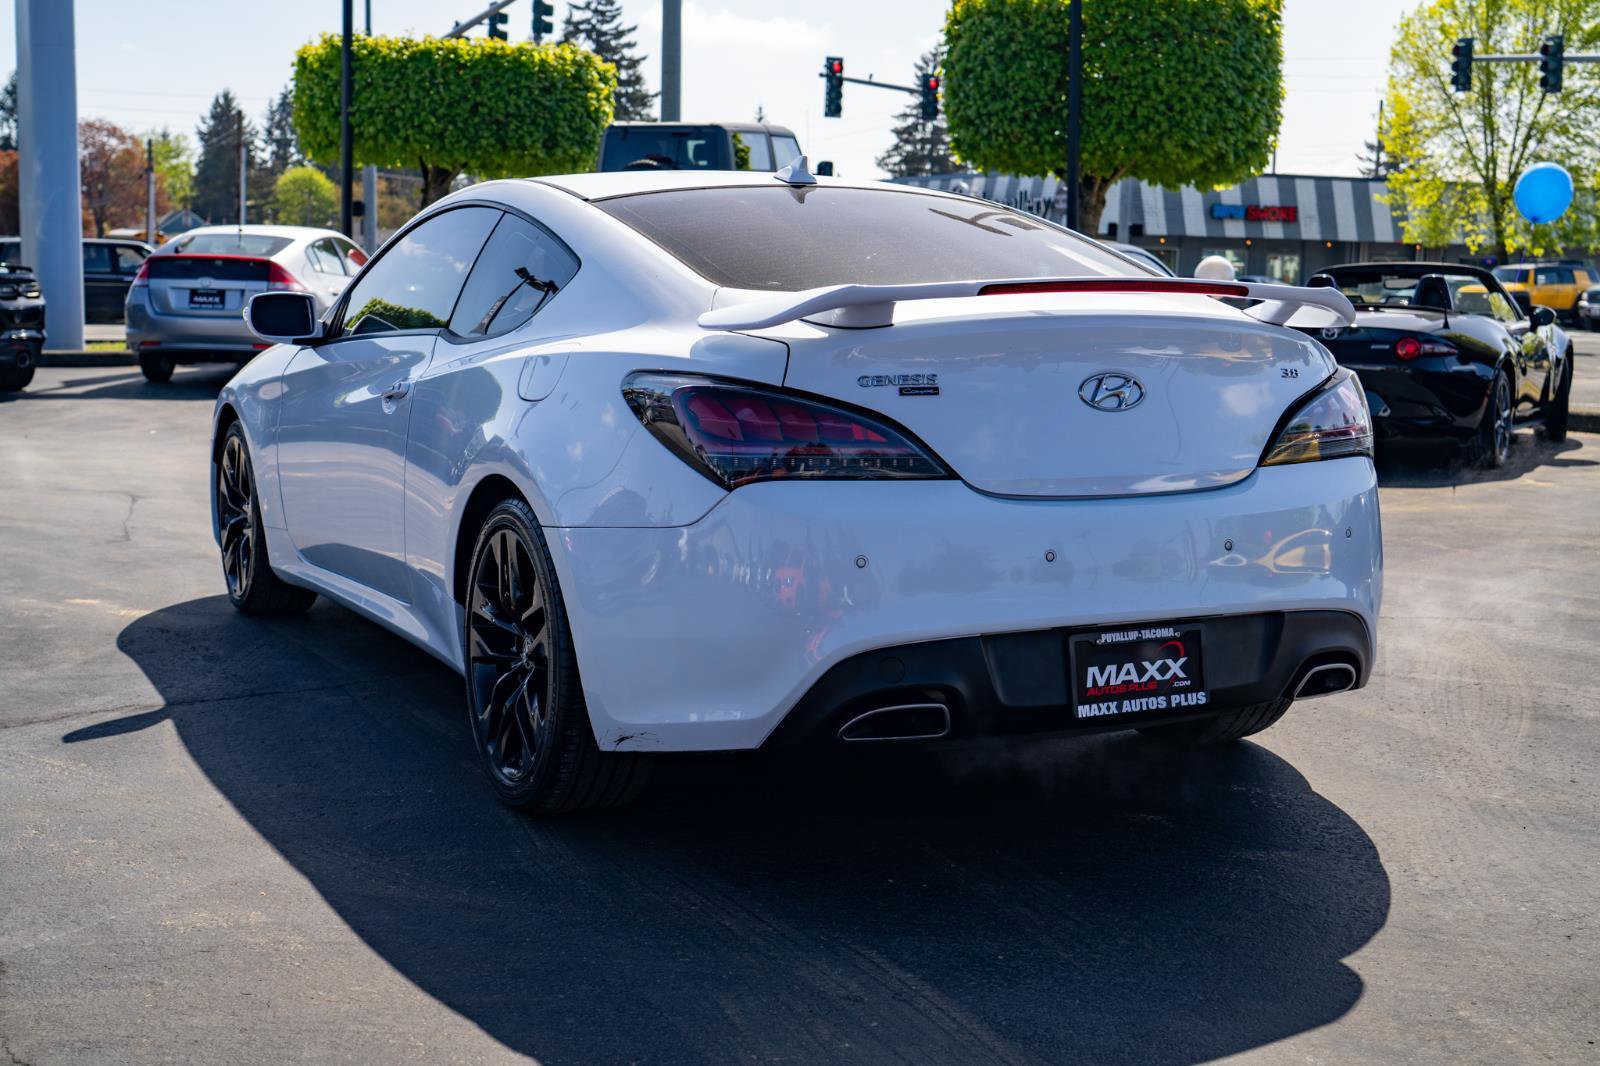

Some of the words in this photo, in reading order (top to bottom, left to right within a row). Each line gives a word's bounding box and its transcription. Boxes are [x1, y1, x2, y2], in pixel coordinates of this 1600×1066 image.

[857, 374, 938, 387] GENESIS
[1086, 657, 1188, 688] MAXX
[1087, 684, 1127, 696] AUTOS
[1128, 681, 1158, 692] PLUS
[1078, 702, 1118, 718] MAXX
[1122, 696, 1167, 712] AUTOS
[1171, 692, 1207, 707] PLUS
